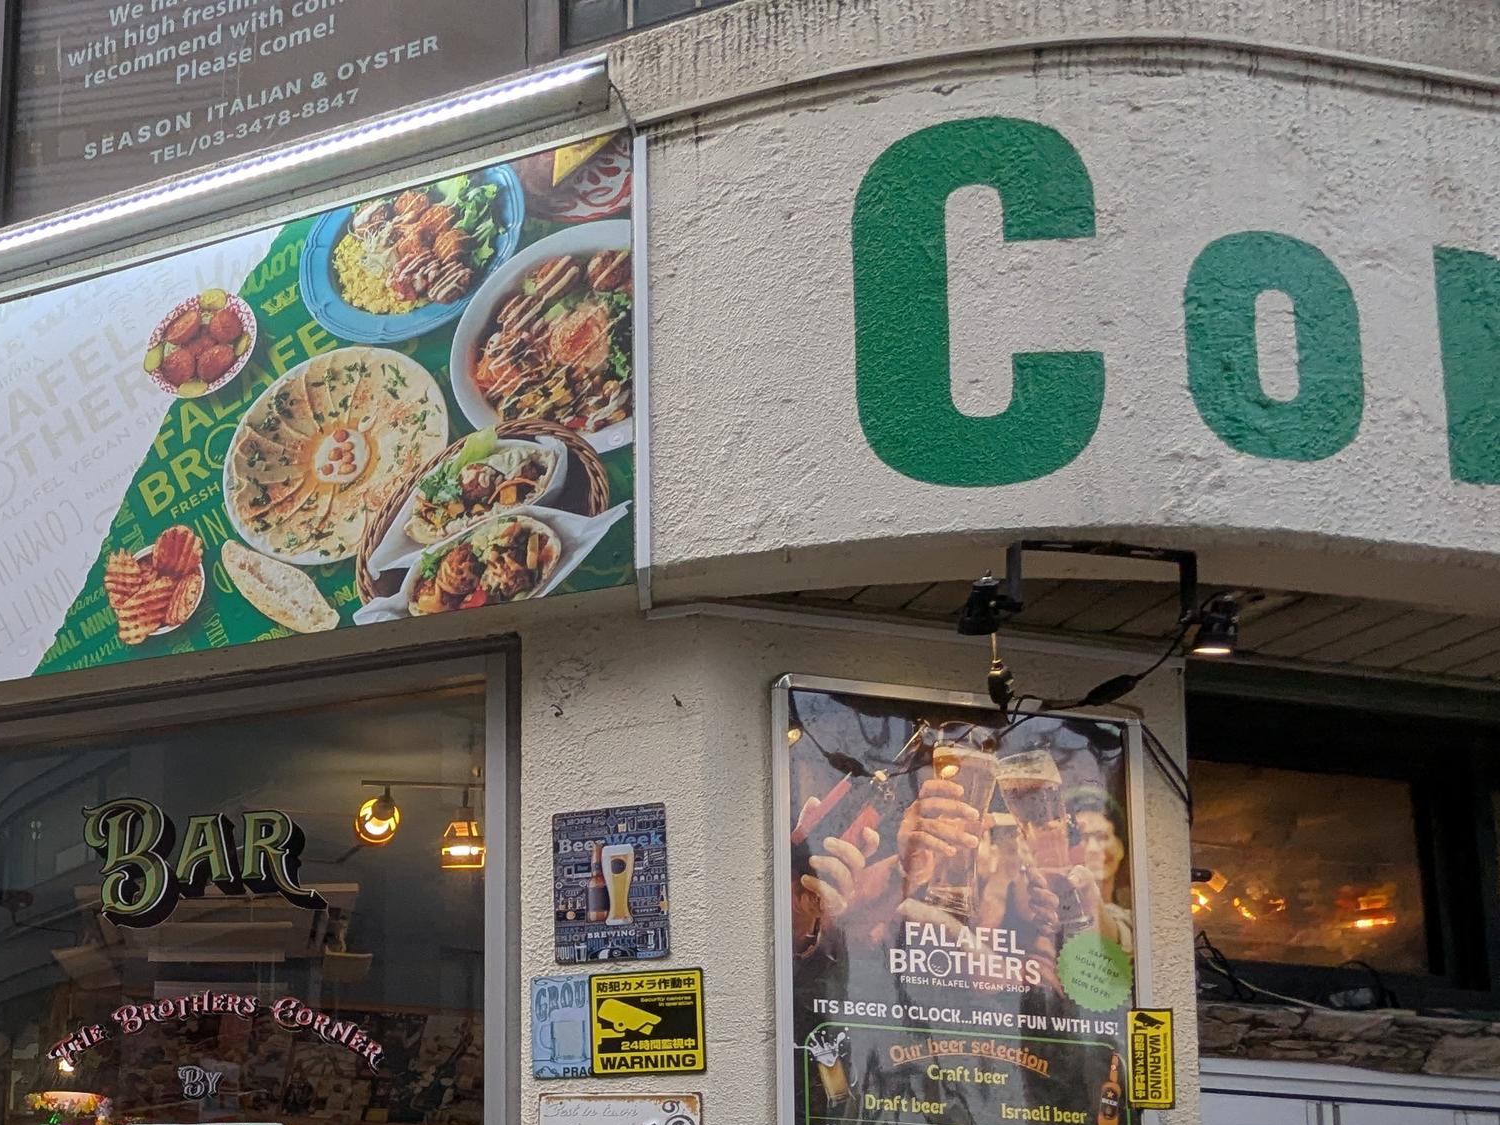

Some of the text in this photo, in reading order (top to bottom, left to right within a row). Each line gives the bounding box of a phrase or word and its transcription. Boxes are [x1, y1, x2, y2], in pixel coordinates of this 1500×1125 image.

[109, 3, 143, 27] We
[68, 36, 118, 68] with
[124, 16, 175, 56] high
[84, 6, 284, 89] recommend with
[175, 14, 336, 85] Please come!
[84, 34, 439, 161] SEASON ITALIAN & OYSTER
[150, 87, 360, 165] TEL/03-3478-8847
[604, 831, 663, 846] Week
[82, 797, 328, 929] BAR
[905, 921, 1025, 955] FALAFEL
[596, 977, 695, 993] 防犯カメラ作動中
[889, 949, 1042, 985] BROTHERS
[900, 975, 1030, 993] FRESH FALAFEL VEGAN SHOP
[813, 999, 839, 1014] ITS
[844, 1001, 887, 1018] BEER
[1017, 1014, 1047, 1030] FUN
[1051, 1016, 1091, 1033] WITH
[1095, 1021, 1119, 1036] US!
[600, 1054, 697, 1070] WARNING
[889, 1038, 1051, 1074] Our beer selection
[1148, 1034, 1162, 1100] WARNING
[927, 1064, 1009, 1085] Craft beer
[865, 1094, 1088, 1124] Draft beer Israeli beer
